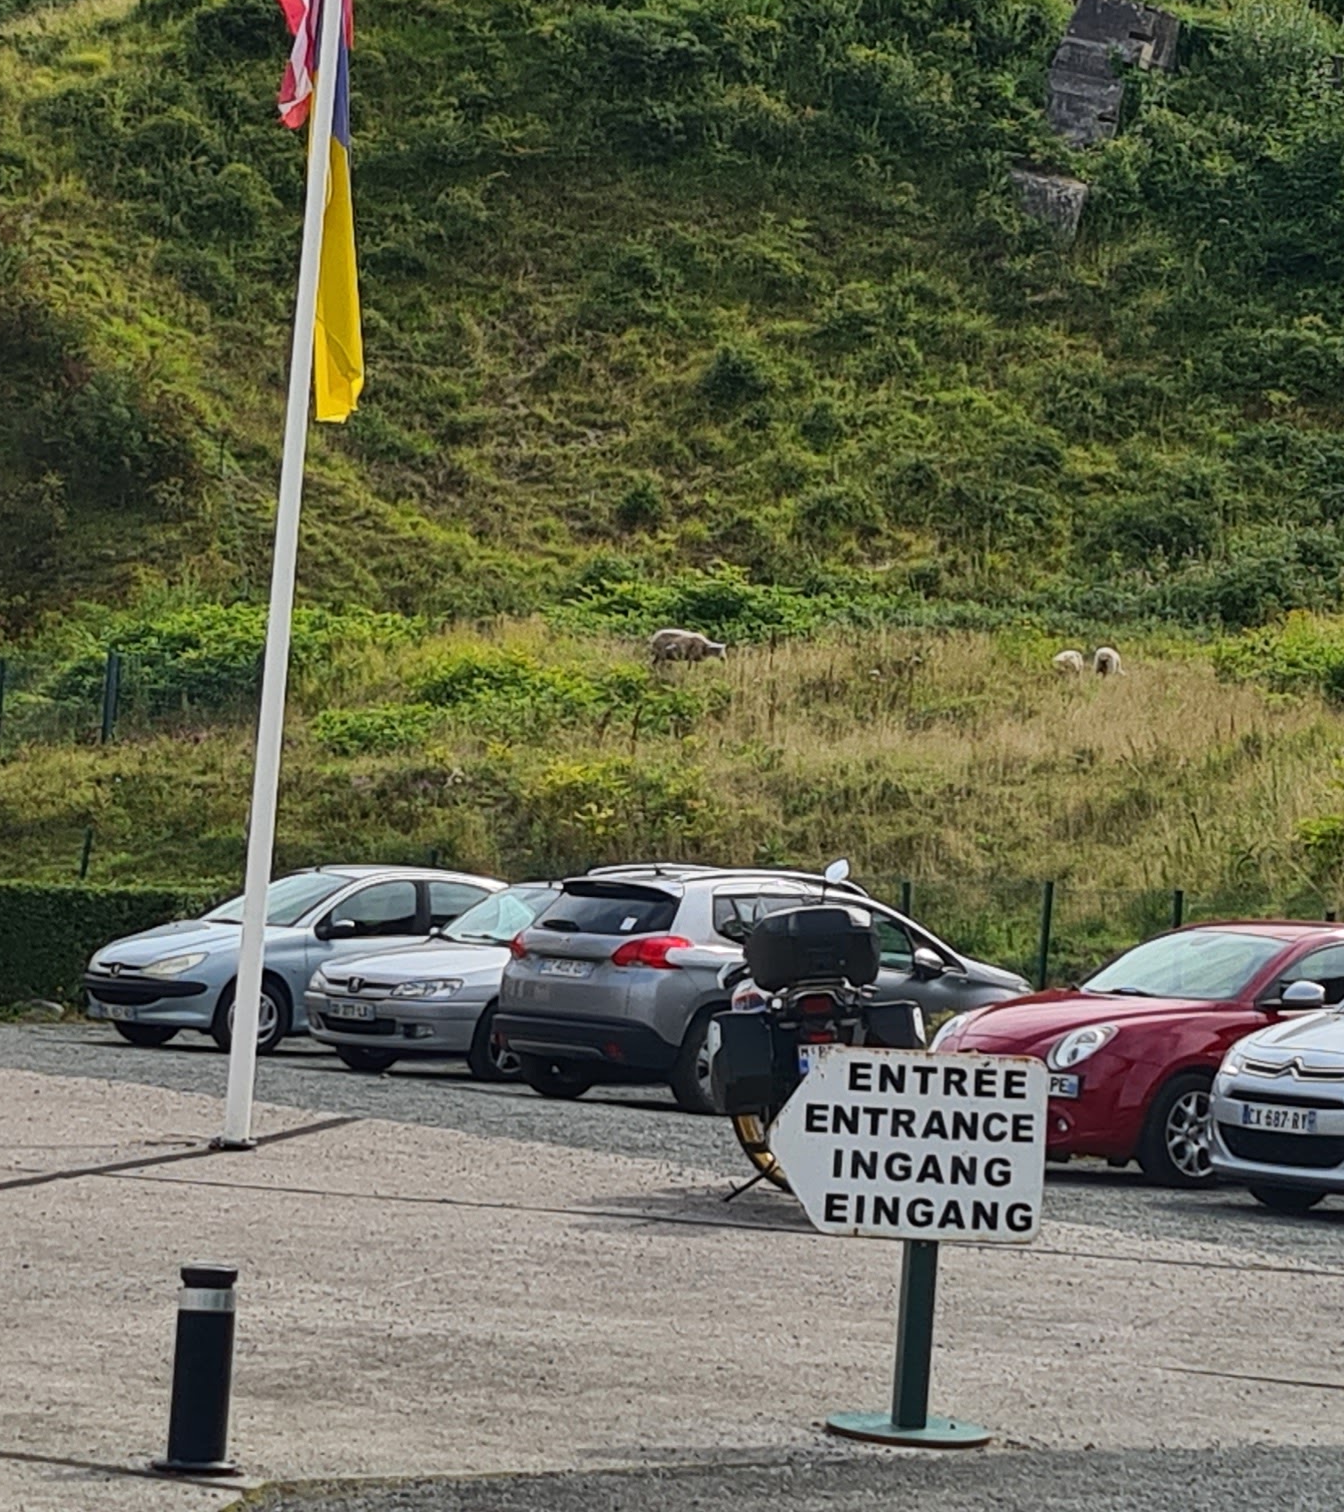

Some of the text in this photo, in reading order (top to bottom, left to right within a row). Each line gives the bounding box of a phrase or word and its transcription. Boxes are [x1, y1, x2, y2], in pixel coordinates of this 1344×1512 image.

[848, 1060, 1027, 1100] ENTRÉE
[805, 1103, 1034, 1143] ENTRANCE
[832, 1149, 1012, 1187] INGANG
[824, 1193, 1033, 1232] EINGANG
